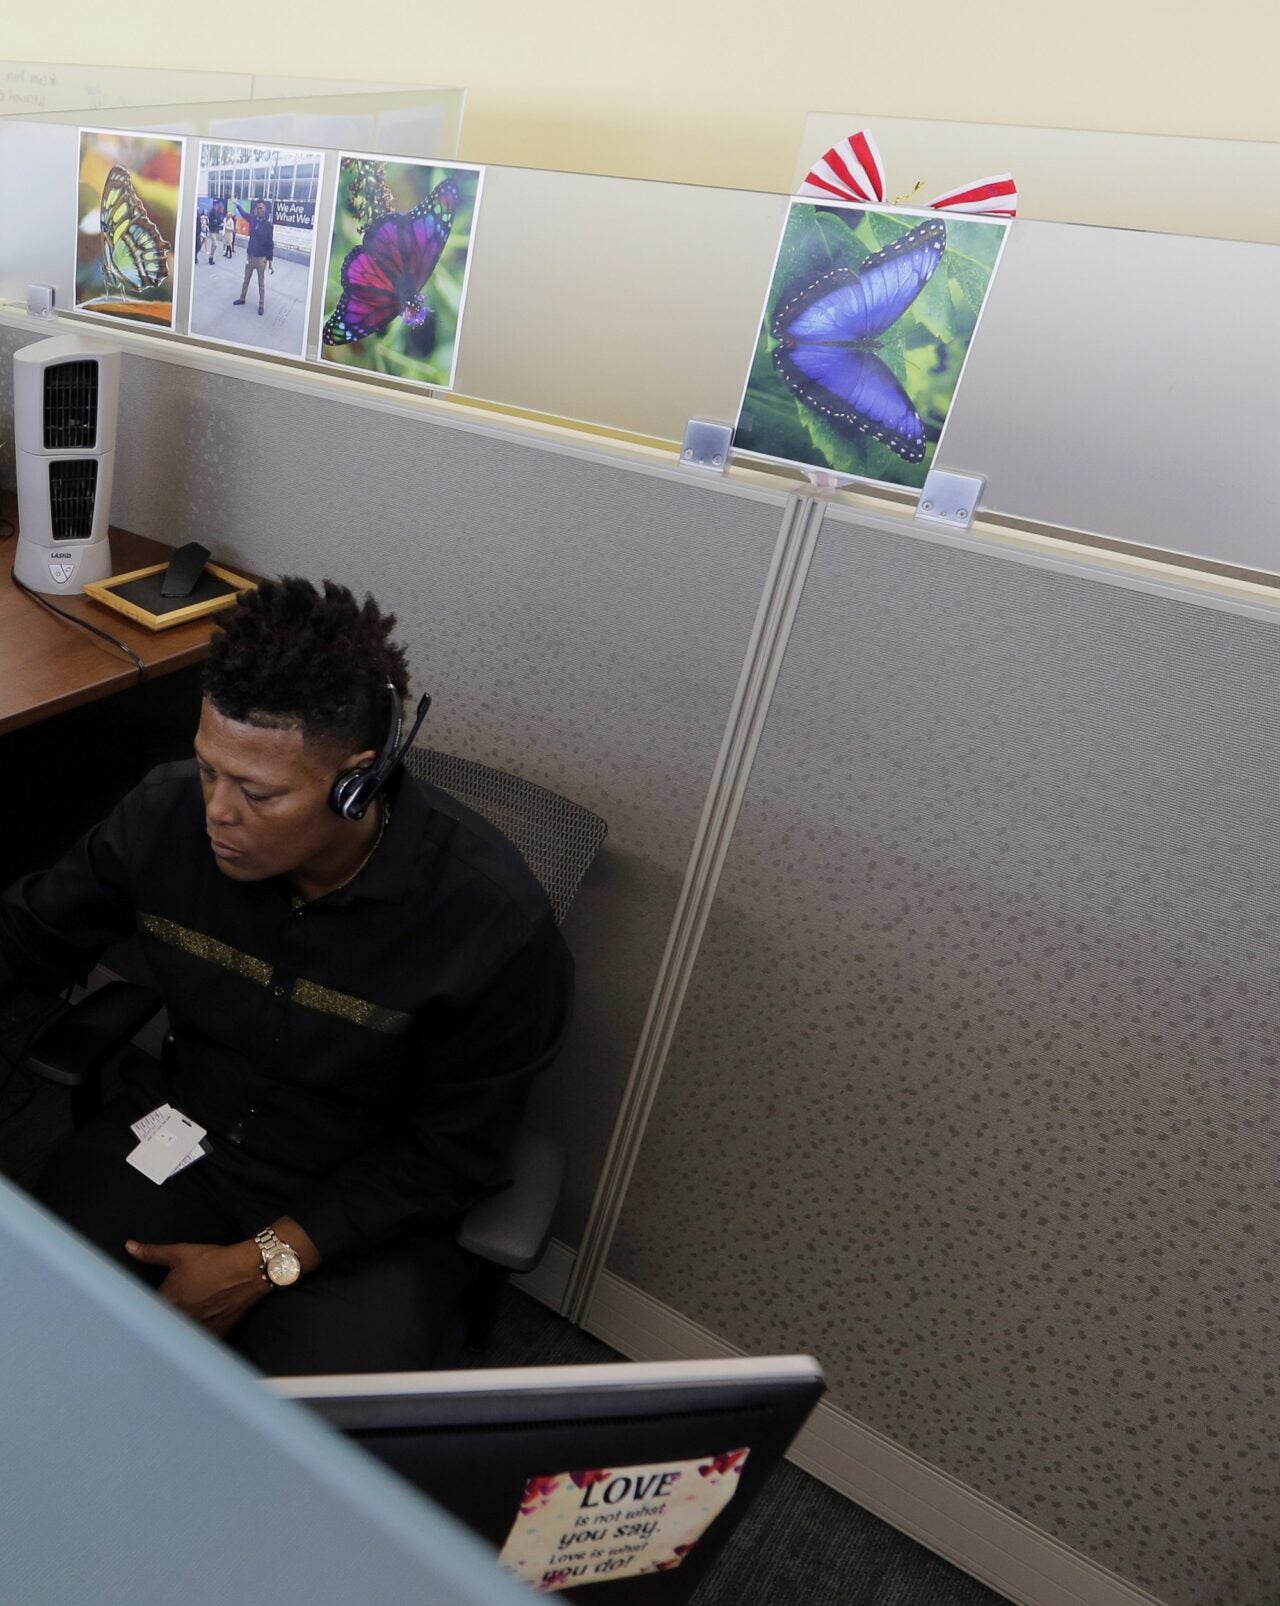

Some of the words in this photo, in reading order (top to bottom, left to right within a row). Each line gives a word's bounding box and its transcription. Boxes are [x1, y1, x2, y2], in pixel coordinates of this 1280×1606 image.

[276, 203, 289, 212] We
[290, 203, 304, 213] Are
[276, 212, 296, 222] What
[296, 213, 310, 224] We
[579, 1472, 682, 1509] LOVE
[574, 1515, 590, 1528] is
[593, 1510, 622, 1525] not
[625, 1503, 667, 1520] what
[557, 1529, 607, 1550] you
[612, 1521, 661, 1539] say.
[549, 1553, 587, 1565] Love
[590, 1548, 604, 1559] is
[608, 1542, 649, 1556] what
[541, 1566, 589, 1584] you
[594, 1556, 636, 1573] do!
